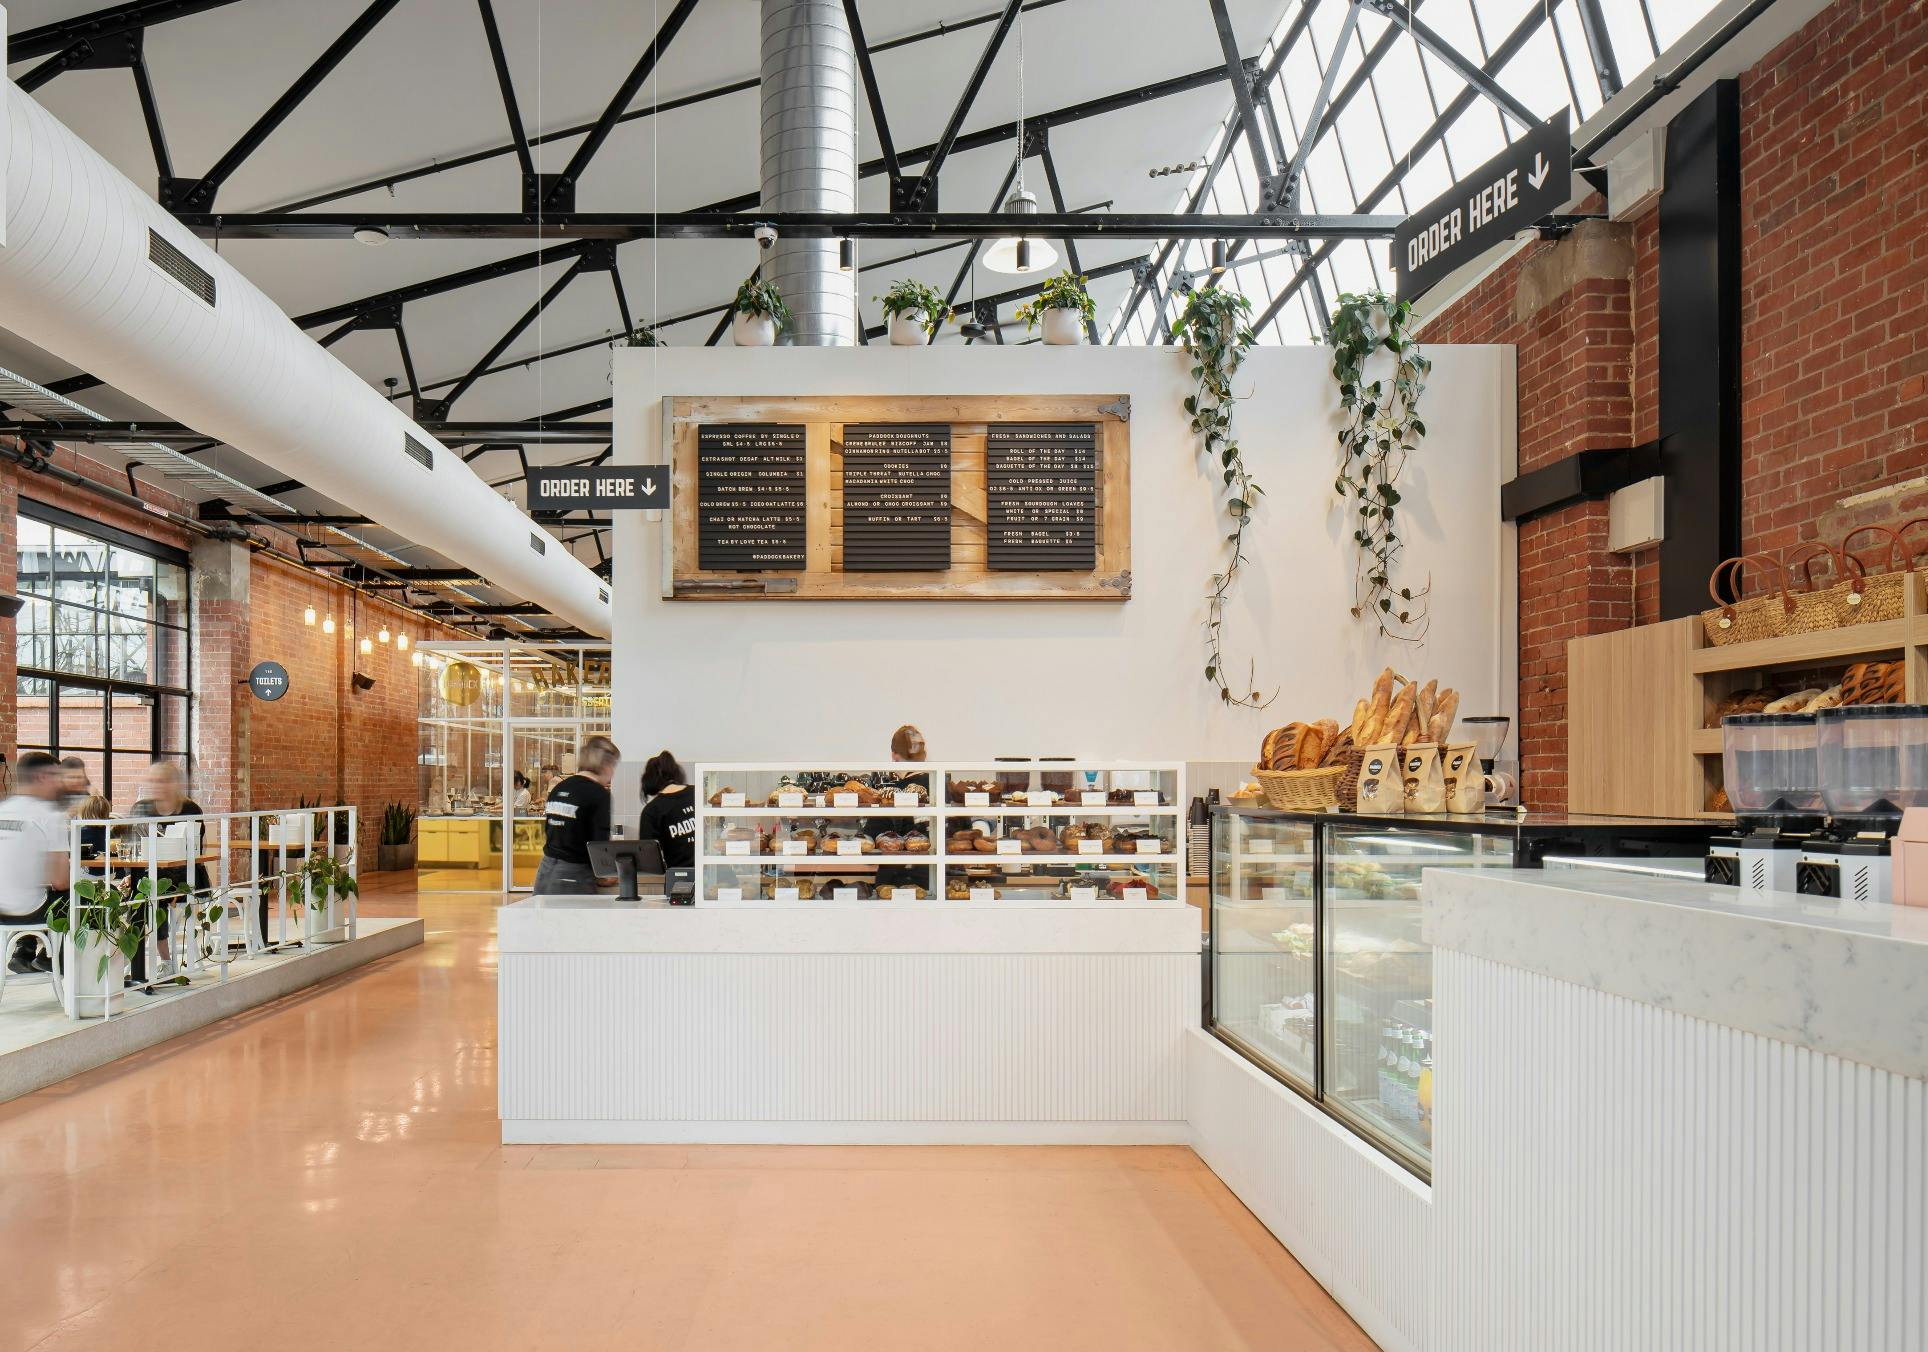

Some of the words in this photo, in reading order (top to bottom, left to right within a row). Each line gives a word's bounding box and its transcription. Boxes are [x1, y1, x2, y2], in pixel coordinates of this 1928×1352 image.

[1408, 207, 1462, 272] ORDER
[1469, 168, 1519, 233] HERE
[540, 479, 590, 497] ORDER
[596, 478, 635, 497] HERE
[256, 677, 282, 685] TOILETS
